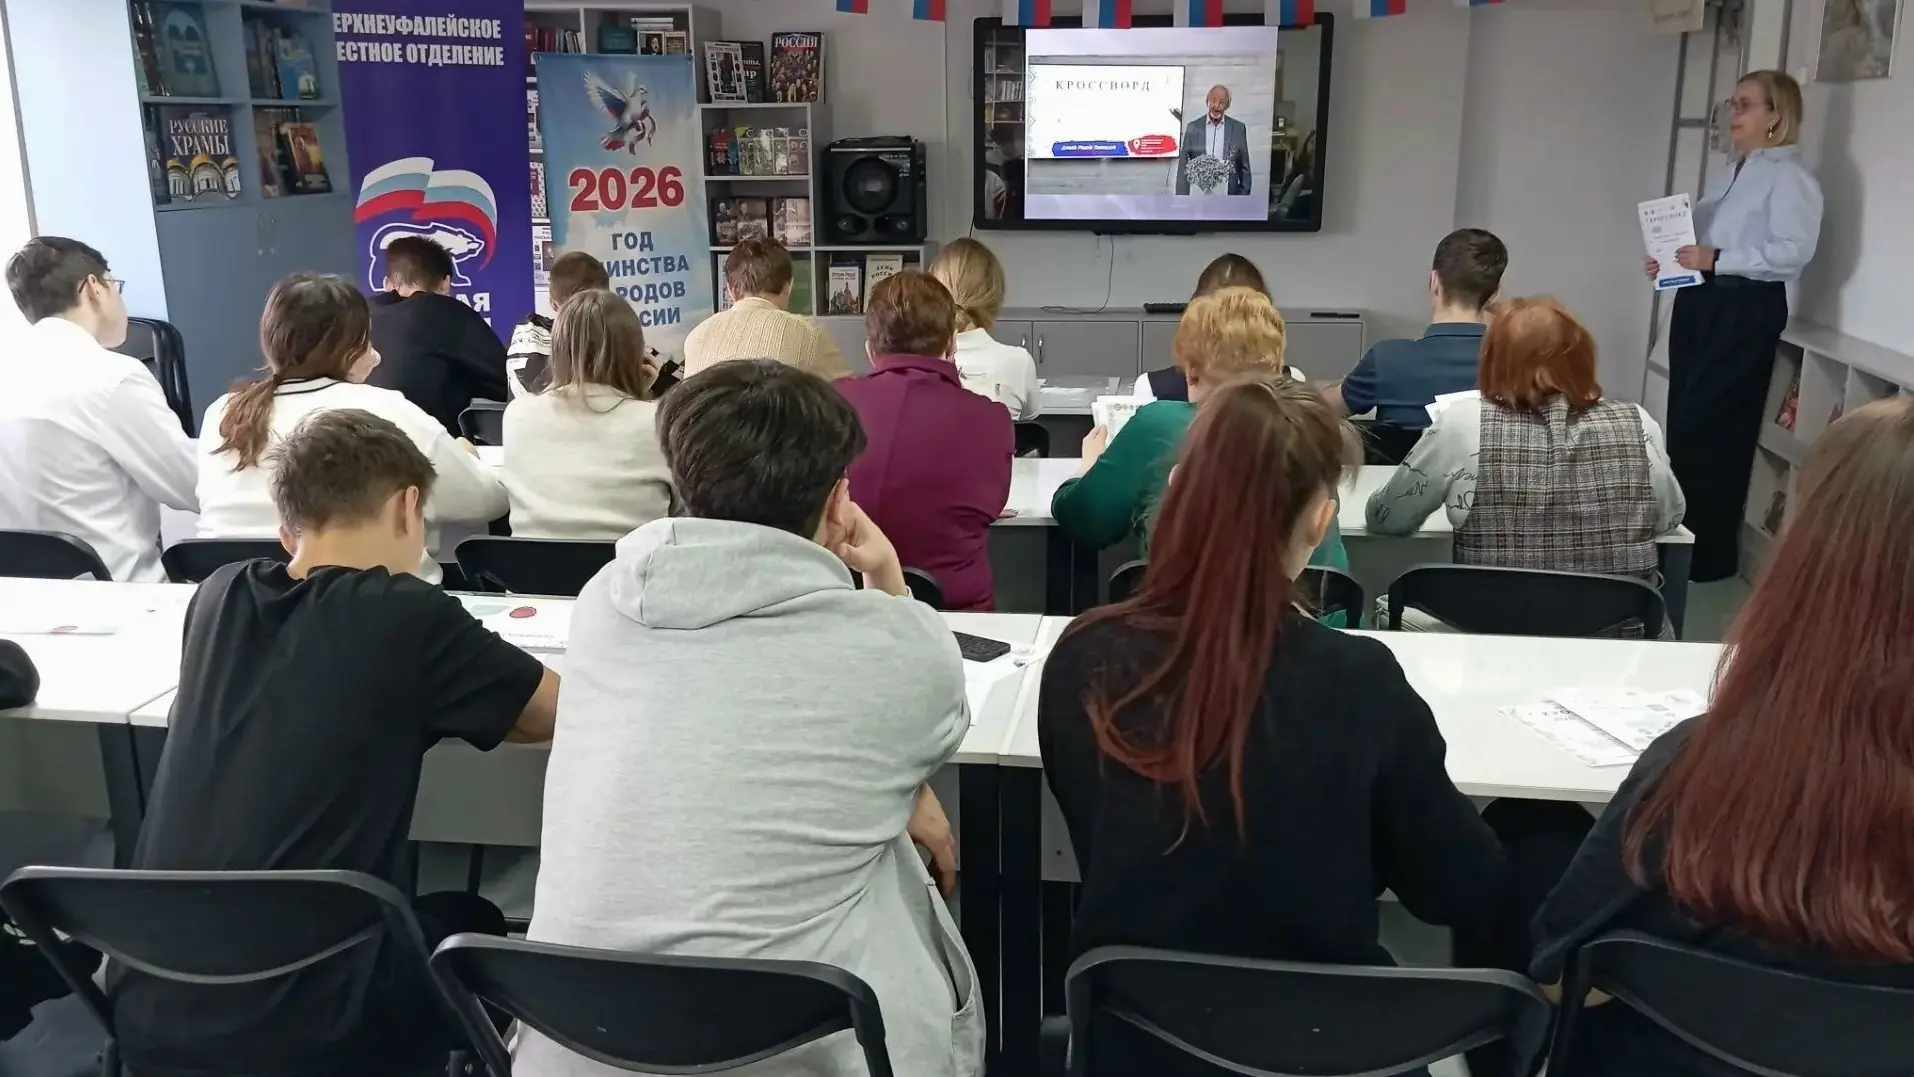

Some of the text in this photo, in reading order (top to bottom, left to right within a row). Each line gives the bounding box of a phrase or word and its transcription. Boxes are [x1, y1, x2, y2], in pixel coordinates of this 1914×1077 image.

[333, 13, 502, 39] ЕРХНЕУФАЛЕЙСКОЕ
[336, 41, 505, 67] ЕСТНОЕ ОТДЕЛЕНИЕ
[1056, 80, 1150, 92] КРОССВОРД
[169, 119, 229, 134] РУССКИЕ
[171, 135, 231, 157] ХРАМЫ
[568, 165, 686, 212] 2026
[611, 231, 654, 252] ГОД
[607, 254, 690, 278] ИНСТВА
[615, 280, 686, 304] РОДОВ
[638, 307, 681, 328] СИИ
